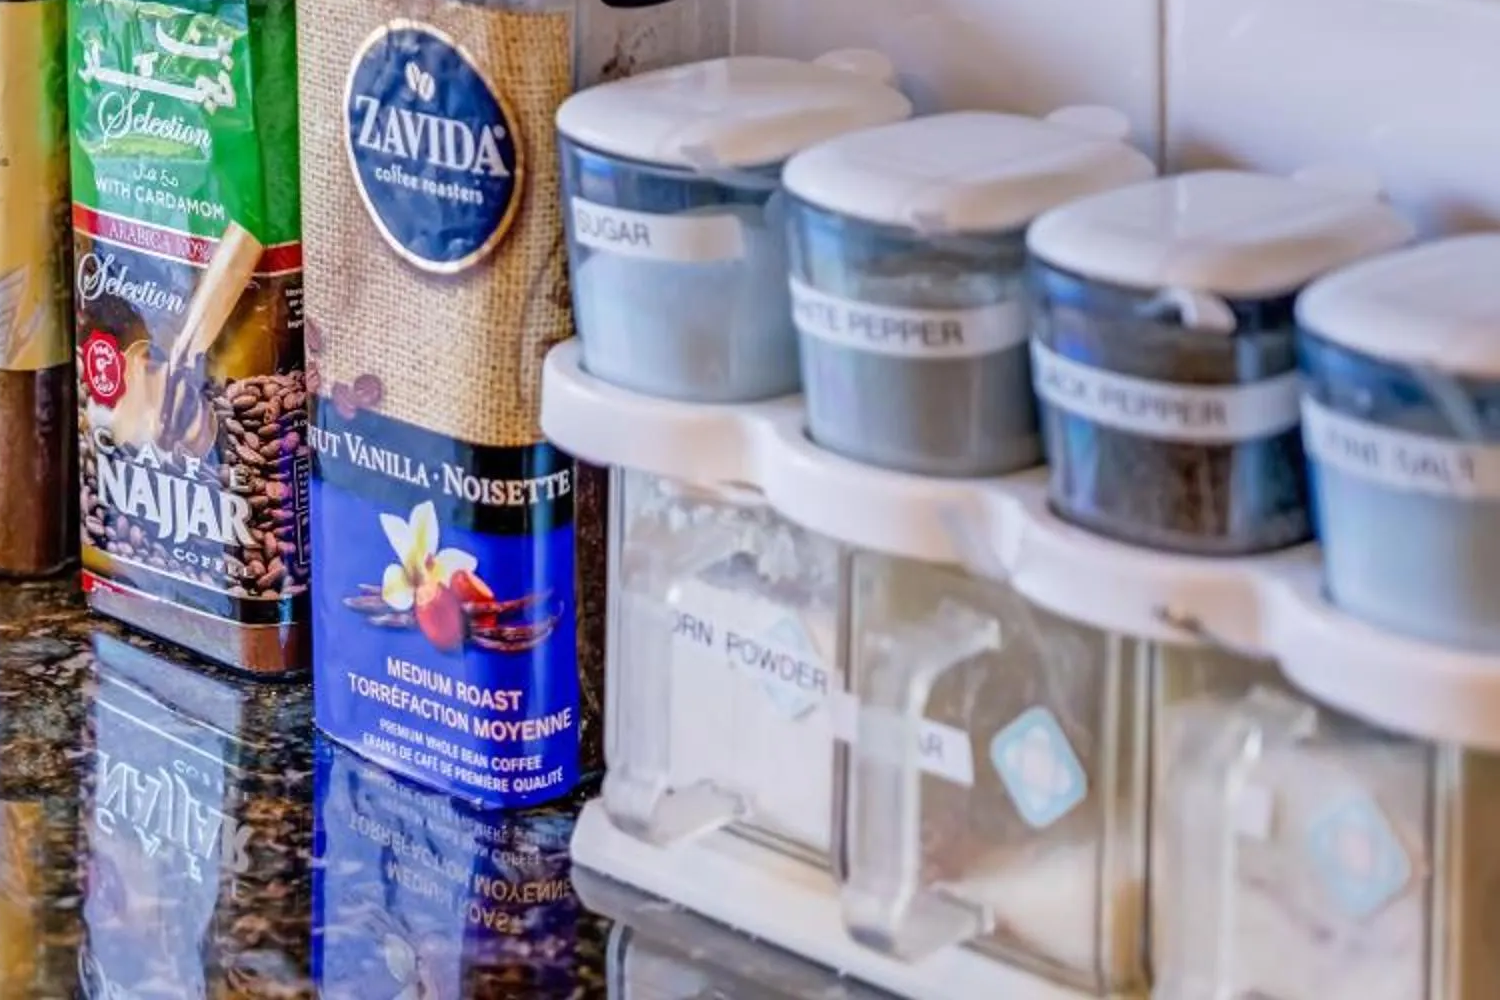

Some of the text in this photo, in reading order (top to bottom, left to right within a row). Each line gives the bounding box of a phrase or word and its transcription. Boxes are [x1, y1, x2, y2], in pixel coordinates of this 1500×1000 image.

[98, 90, 212, 156] Selection
[354, 94, 511, 178] ZAVIDA
[96, 177, 226, 218] WITH CARDAMOM
[375, 163, 484, 205] coffee roasters
[108, 221, 171, 251] ARABICA
[577, 208, 652, 248] SUGAR
[78, 252, 186, 316] Selection
[848, 310, 964, 346] PEPPER
[95, 452, 262, 548] NAJJAR
[172, 546, 255, 579] COFFEE
[386, 656, 523, 712] MEDIUM ROAST
[726, 630, 829, 696] POWDER
[348, 672, 573, 743] TORRÉFACTION MOYENNE
[379, 718, 543, 773] PREMIUM WHOLE BEAN COFFEE
[399, 746, 413, 762] DE
[440, 761, 453, 777] DE
[453, 764, 510, 793] PREMIÈRE
[512, 765, 564, 793] QUALITÉ
